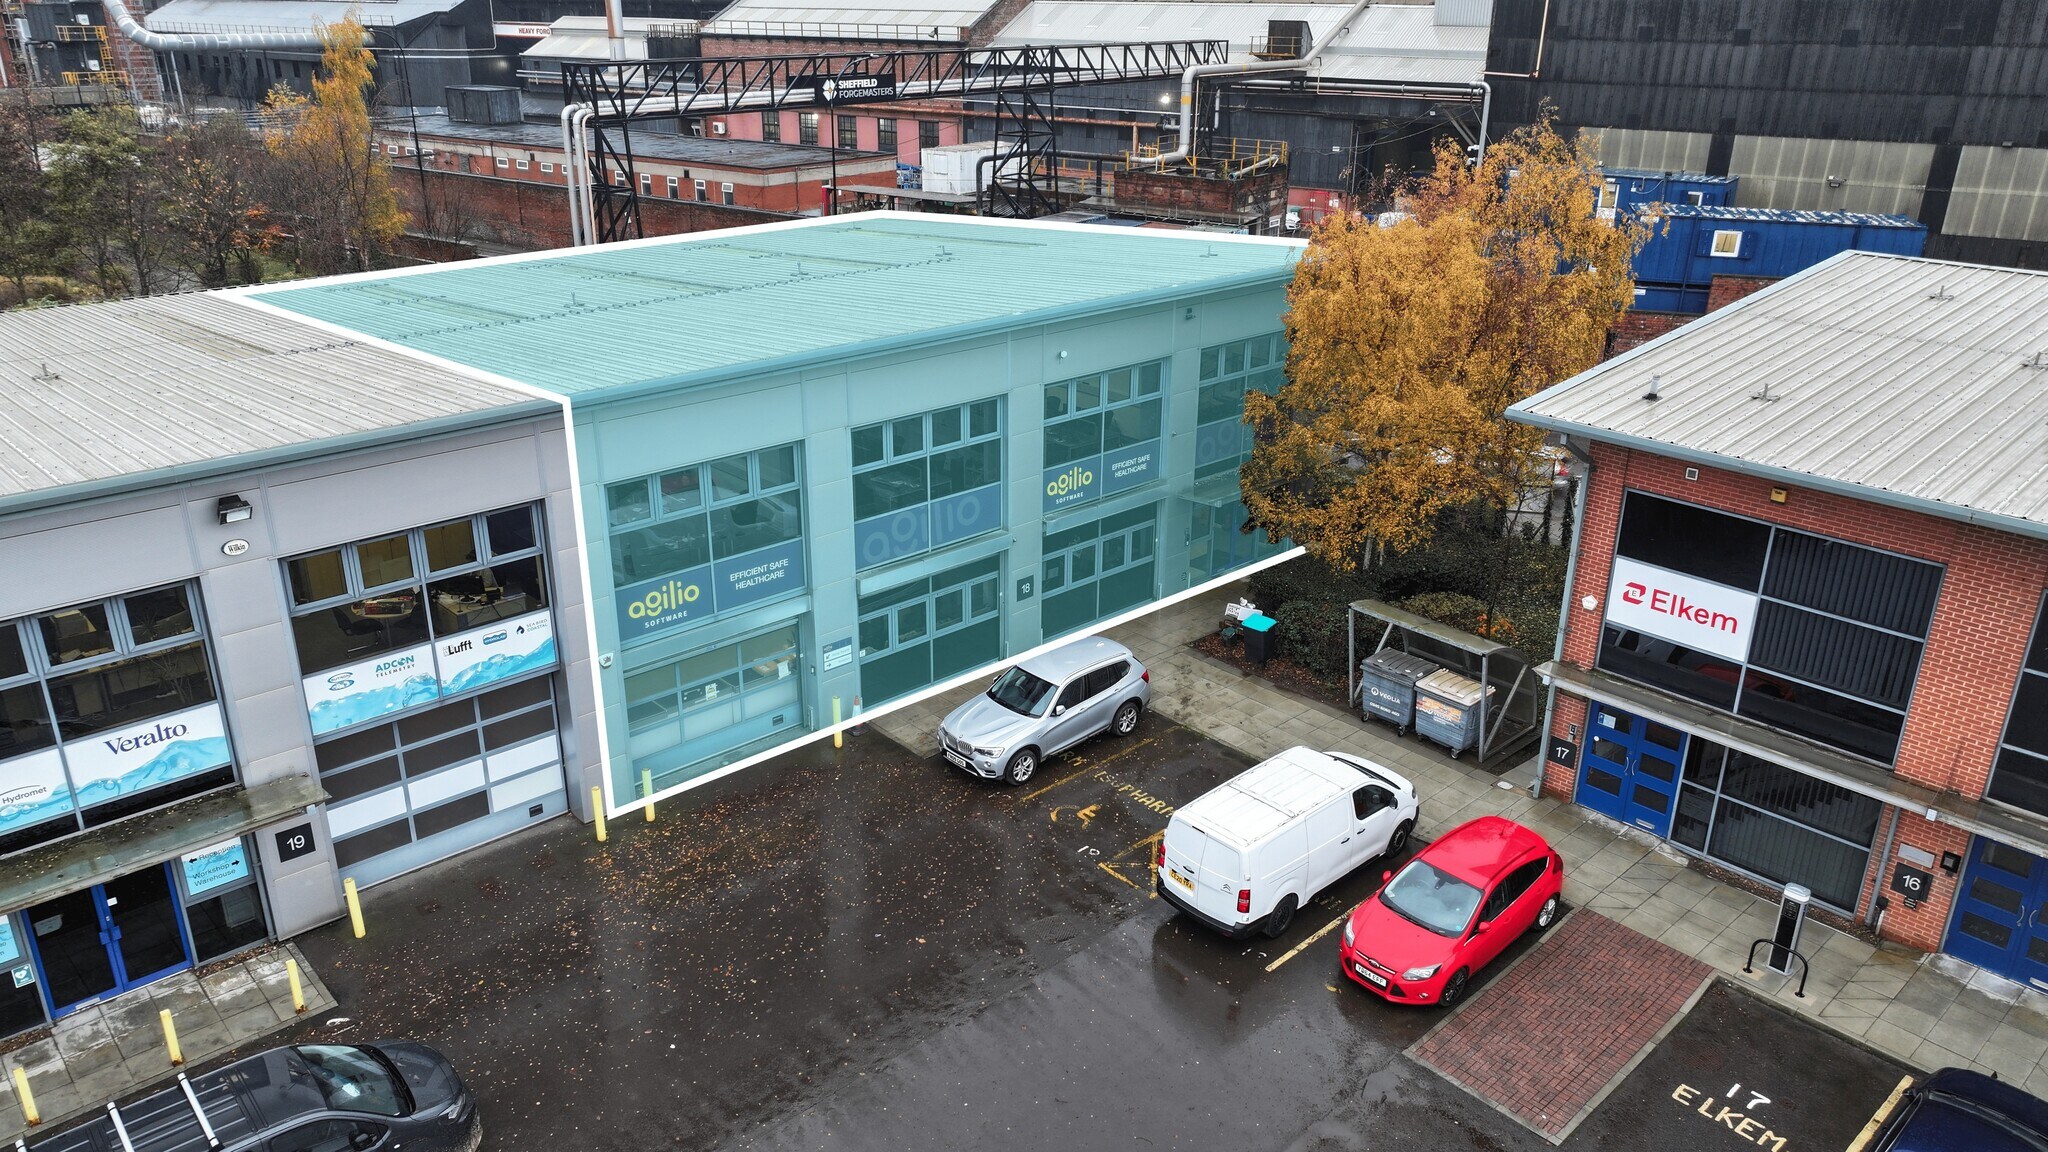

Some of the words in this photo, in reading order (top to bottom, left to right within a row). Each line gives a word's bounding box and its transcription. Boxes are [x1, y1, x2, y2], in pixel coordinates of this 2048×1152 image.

[838, 79, 878, 89] SHEFFIELD
[839, 87, 894, 98] FORGEMASTERS
[1111, 457, 1137, 471] EFFICIENT
[1137, 454, 1151, 464] SAFE
[1114, 463, 1147, 478] HEALTHCARE
[1047, 466, 1093, 496] agilio
[1055, 491, 1084, 505] SOFTWARE
[729, 563, 768, 582] EFFICIENT
[769, 558, 789, 571] SAFE
[735, 569, 785, 590] HEALTHCARE
[1021, 582, 1031, 594] 18
[628, 580, 700, 619] agilio
[644, 610, 688, 629] SOFTWARE
[1650, 588, 1738, 634] Elkem
[447, 640, 473, 655] Lufft
[375, 655, 415, 673] ADCON
[375, 664, 415, 678] TELEMETRY
[1379, 691, 1401, 704] VEOLIA
[103, 724, 187, 755] Veralto
[1556, 747, 1570, 760] 17
[2, 786, 47, 803] Hydromet
[286, 835, 305, 851] 19
[198, 843, 236, 861] Reception
[192, 862, 230, 879] Workshop
[193, 868, 236, 887] Warehouse
[1902, 874, 1921, 891] 16
[1726, 1083, 1771, 1109] 17
[1671, 1083, 1787, 1152] ELKEM
